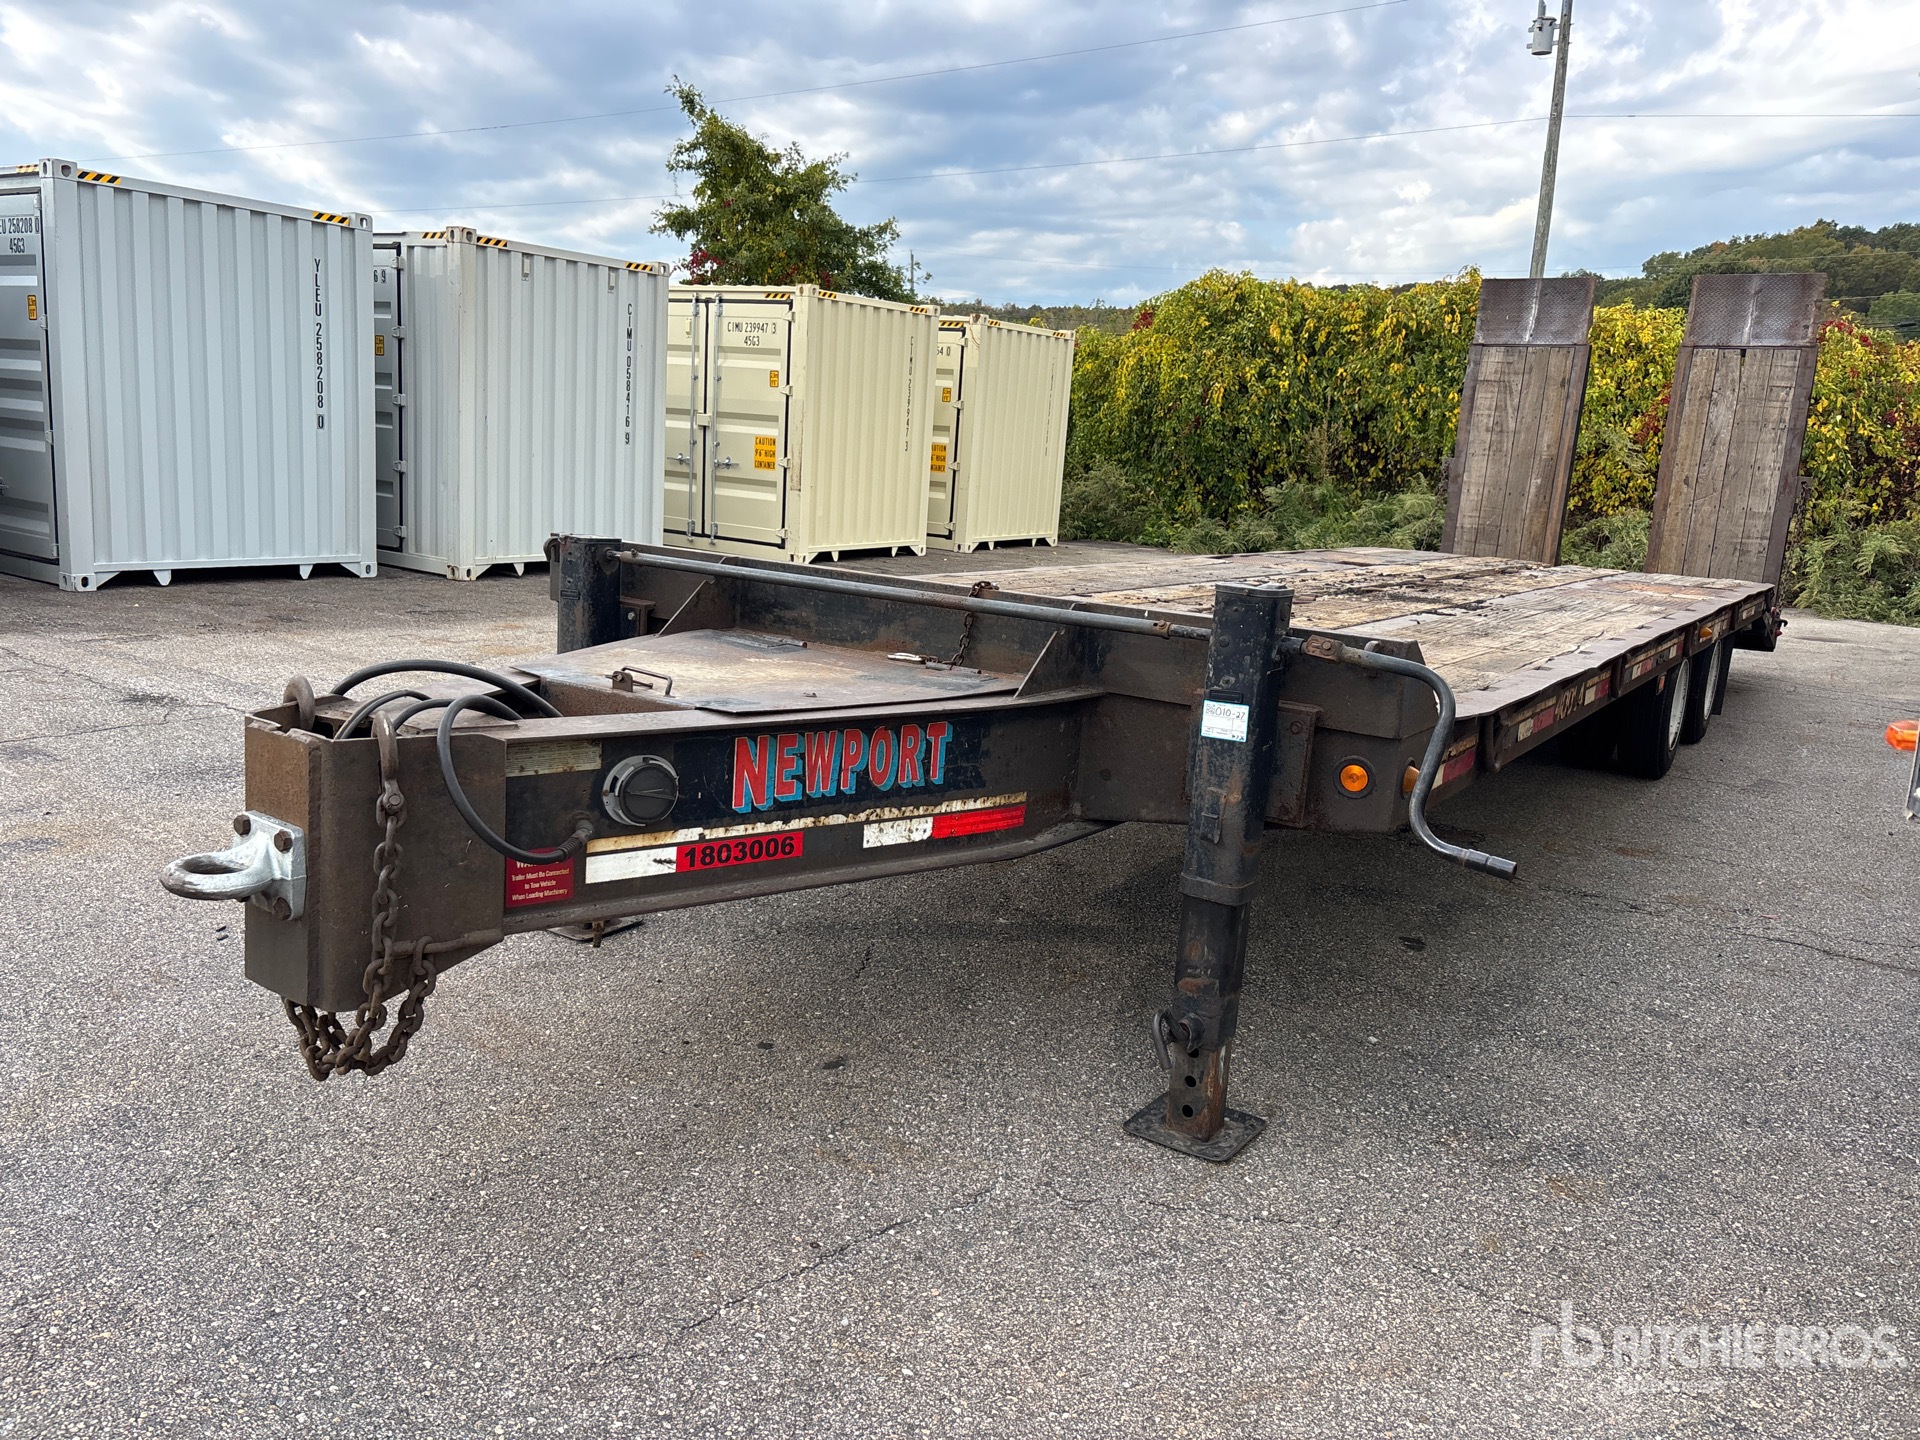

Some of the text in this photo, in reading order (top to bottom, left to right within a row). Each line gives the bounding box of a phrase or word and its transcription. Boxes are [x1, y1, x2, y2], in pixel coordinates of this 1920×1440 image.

[8, 217, 33, 234] 258208
[35, 217, 40, 234] 0
[727, 321, 777, 334] CIMU 239947 3
[313, 258, 325, 430] YLEU 258208 0
[624, 432, 630, 445] 9
[732, 721, 953, 814] NEWPORT
[684, 835, 796, 869] 1803006
